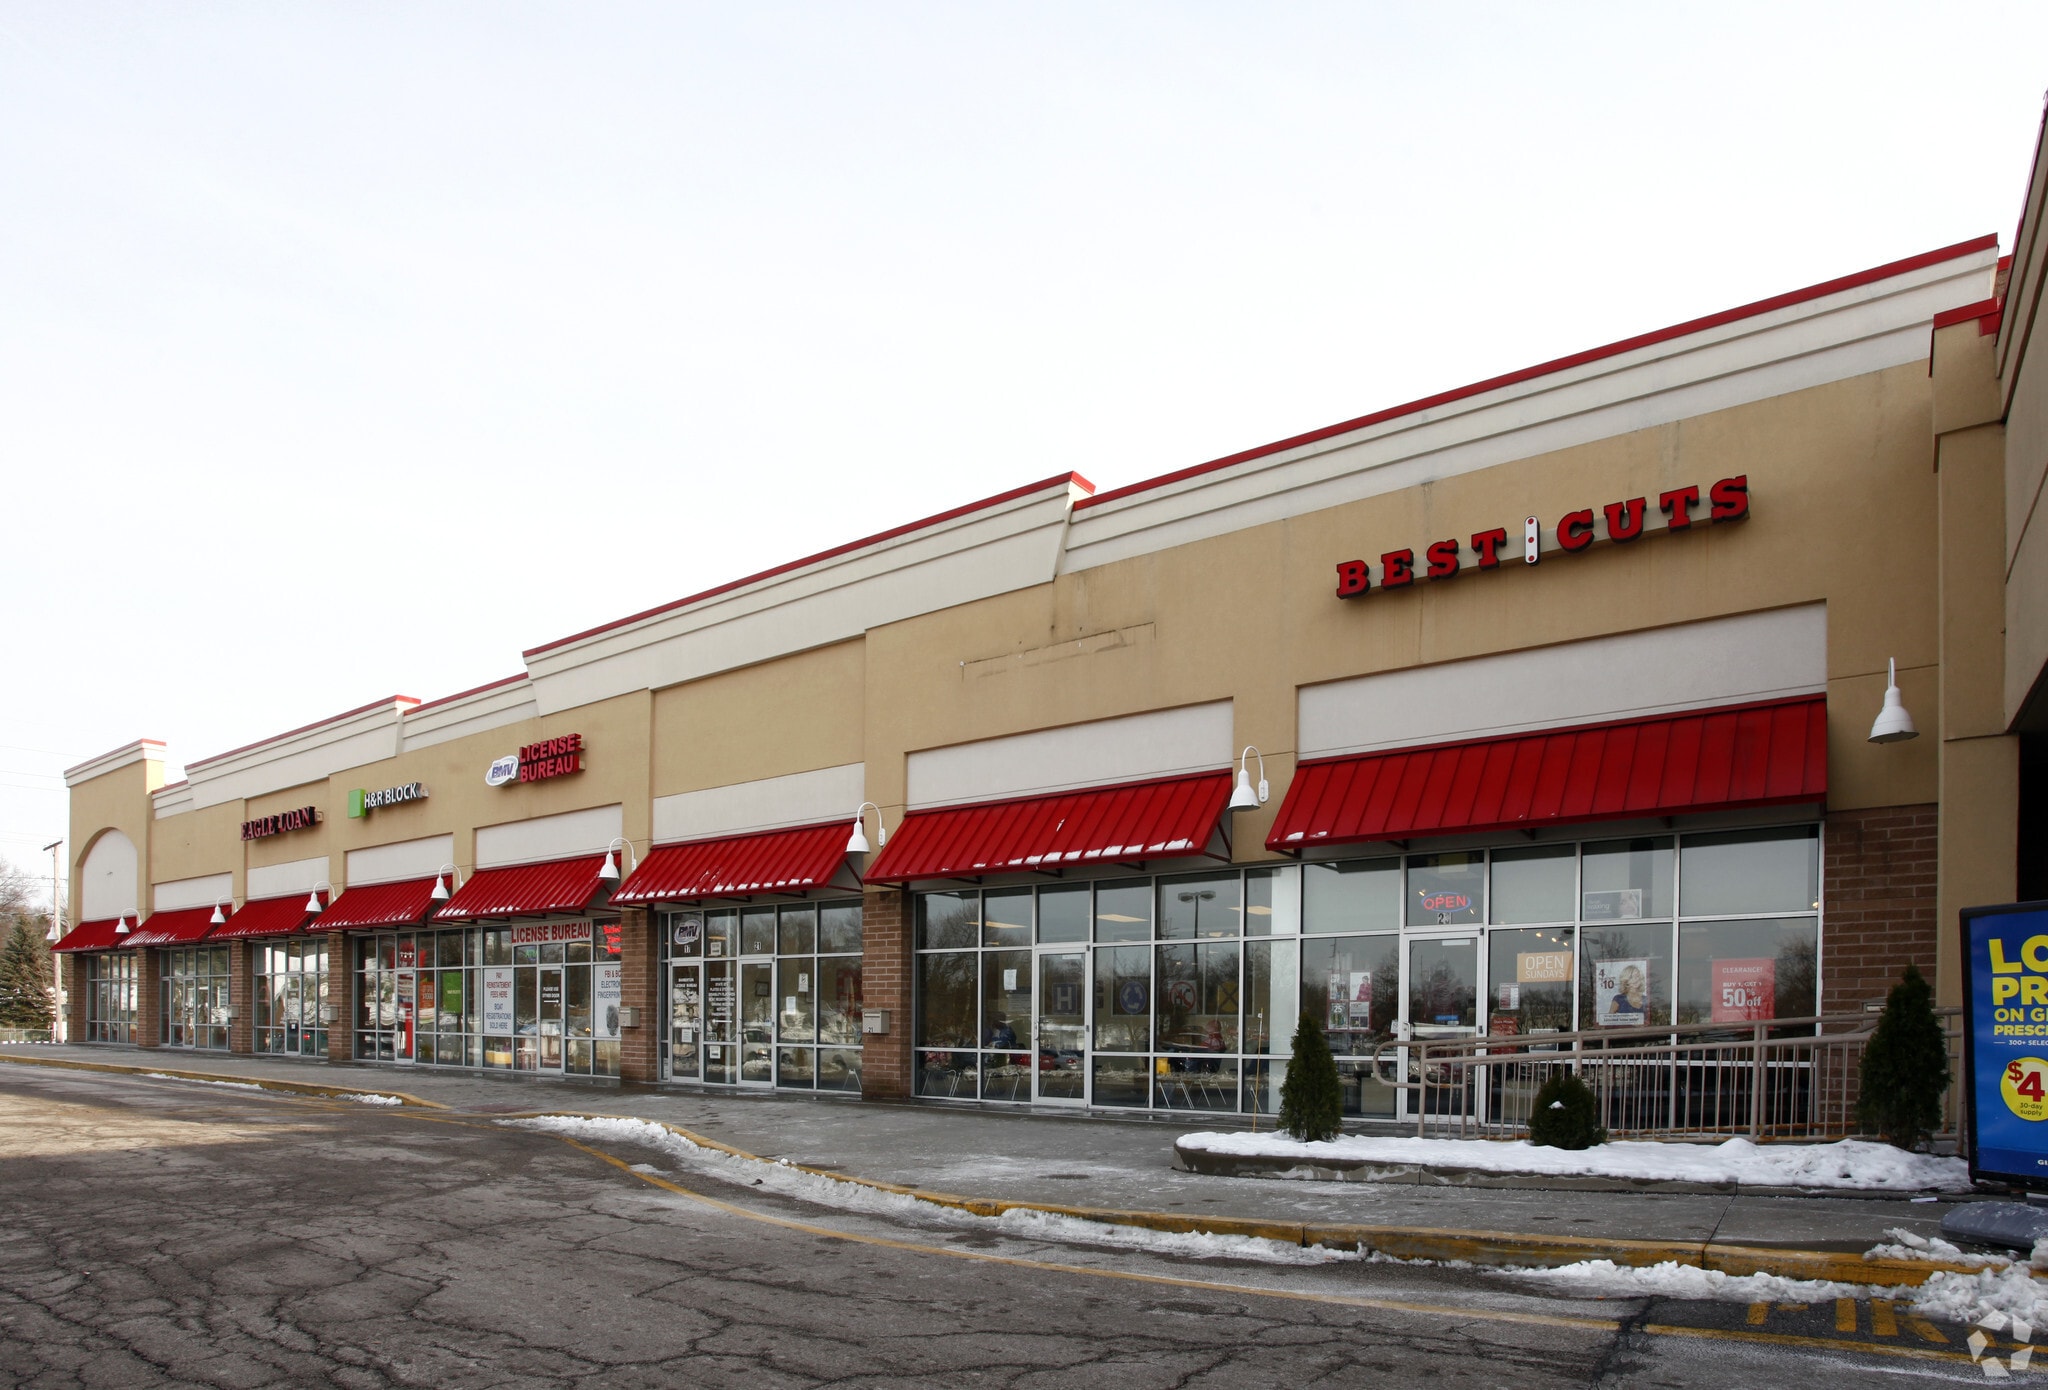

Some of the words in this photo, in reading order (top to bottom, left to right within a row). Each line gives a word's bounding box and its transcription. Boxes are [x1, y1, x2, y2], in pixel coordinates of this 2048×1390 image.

[1336, 527, 1507, 599] BEST
[1556, 475, 1750, 553] CUTS
[519, 733, 578, 763] LICENSE
[491, 763, 514, 779] BMV
[520, 754, 576, 783] BUREAU
[364, 791, 383, 809] H&R
[385, 782, 419, 804] BLOCK
[240, 814, 277, 841] EAGLE
[278, 806, 316, 833] LOAN
[1423, 895, 1467, 910] OPEN
[511, 925, 549, 944] LICENSE
[552, 922, 591, 941] BUREAU
[1525, 955, 1565, 971] OPEN
[1722, 966, 1763, 974] CLEARANCE!
[1525, 969, 1565, 979] SUNDAYS
[1747, 995, 1762, 1007] off
[1994, 1008, 2024, 1022] ON
[2030, 1007, 2048, 1022] G
[1993, 1024, 2048, 1036] PRESC
[2007, 1060, 2045, 1103] $4
[2020, 1102, 2043, 1111] 30-day
[2020, 1109, 2043, 1117] supply
